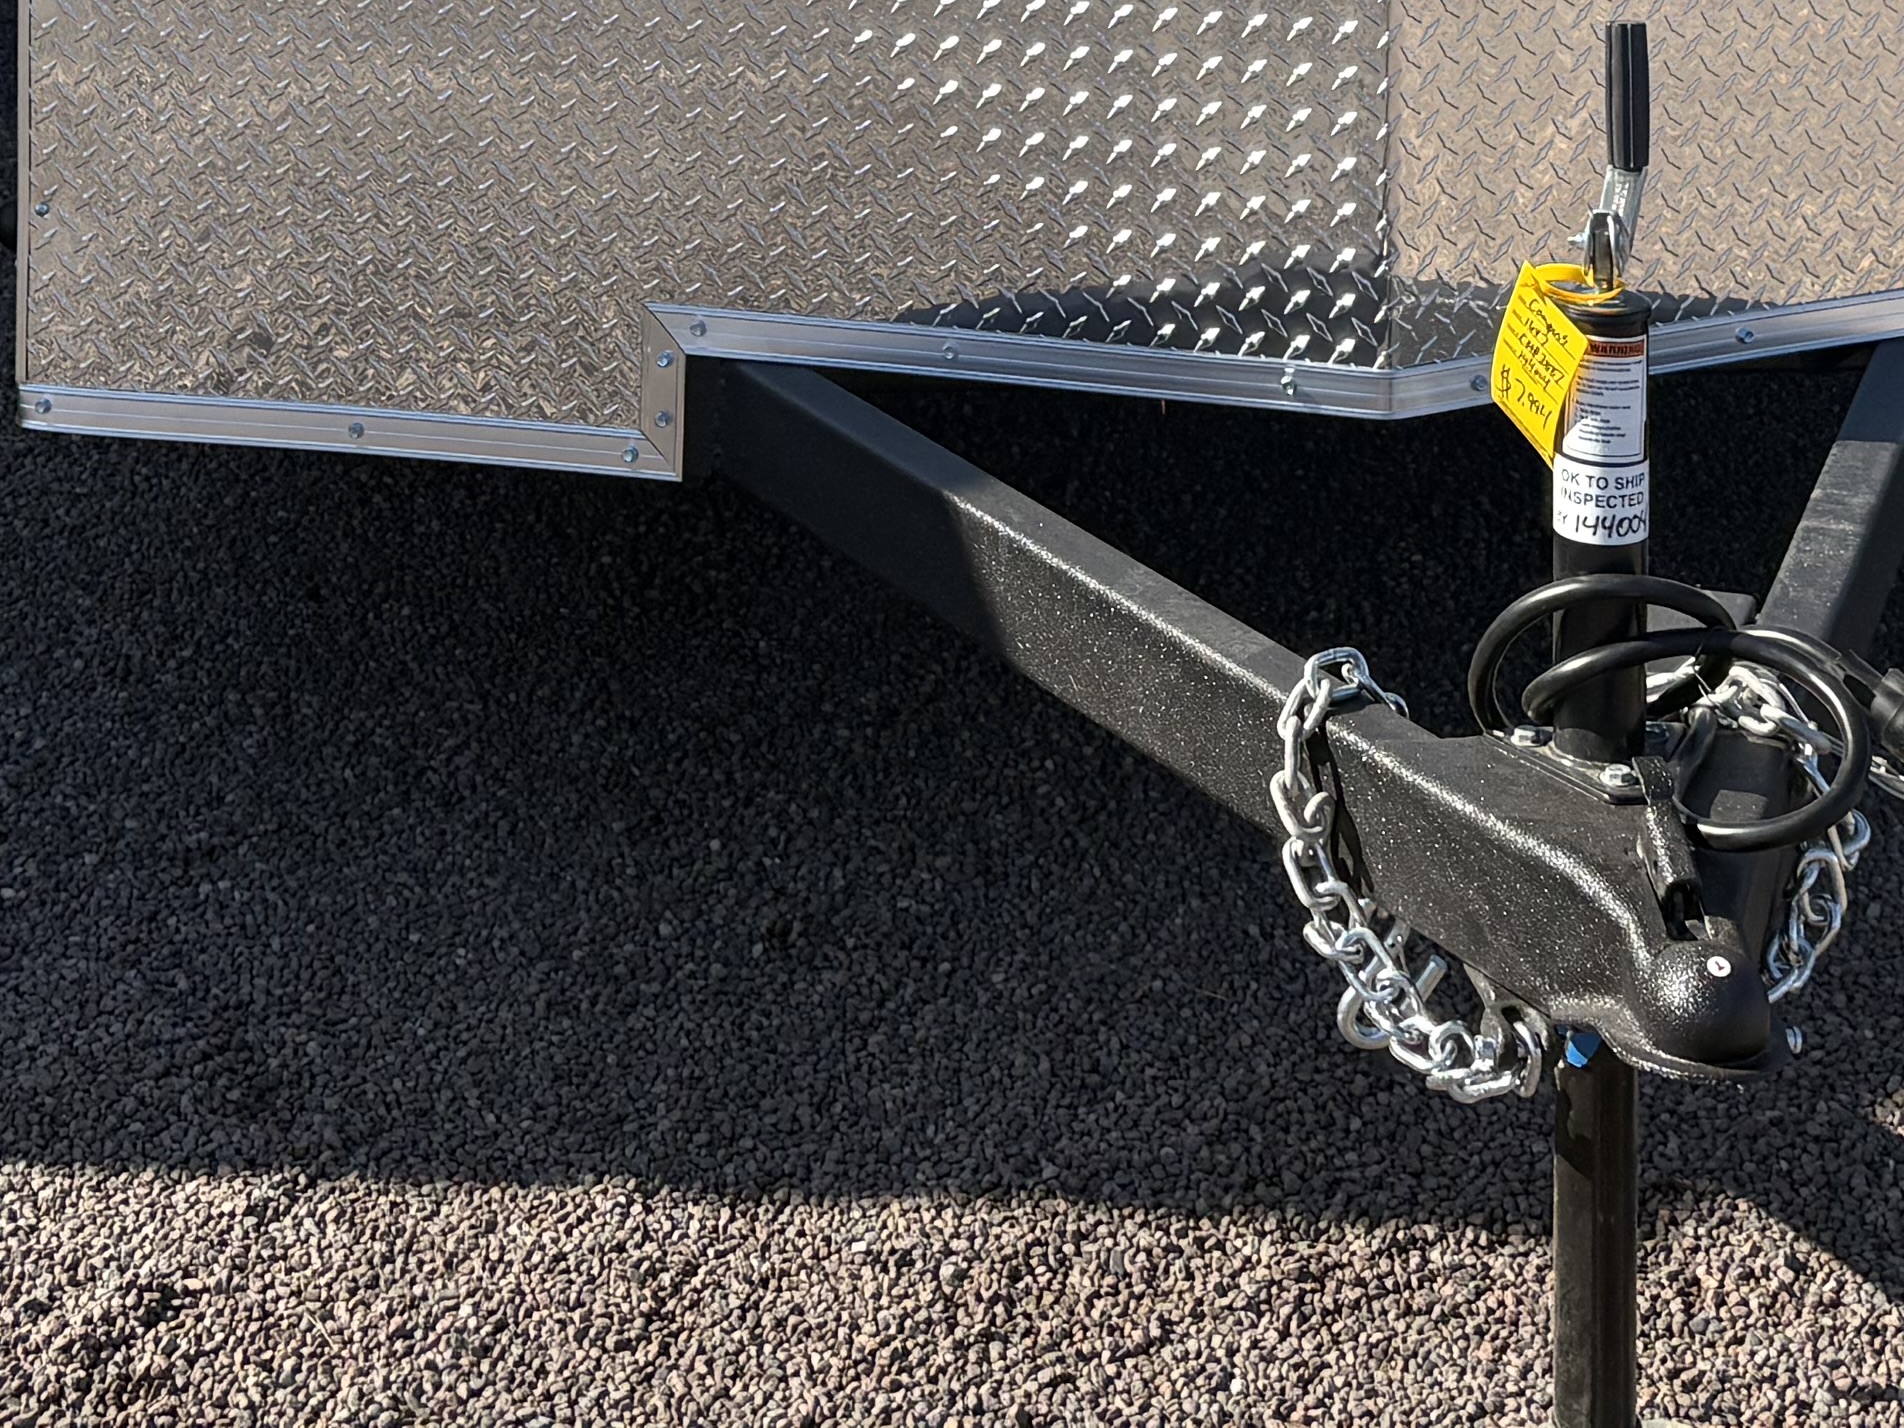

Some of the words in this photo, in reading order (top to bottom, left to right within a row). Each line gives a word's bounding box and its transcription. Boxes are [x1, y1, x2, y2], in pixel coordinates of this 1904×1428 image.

[1561, 469, 1580, 486] OK
[1585, 475, 1609, 490] TO
[1614, 472, 1645, 490] SHIP
